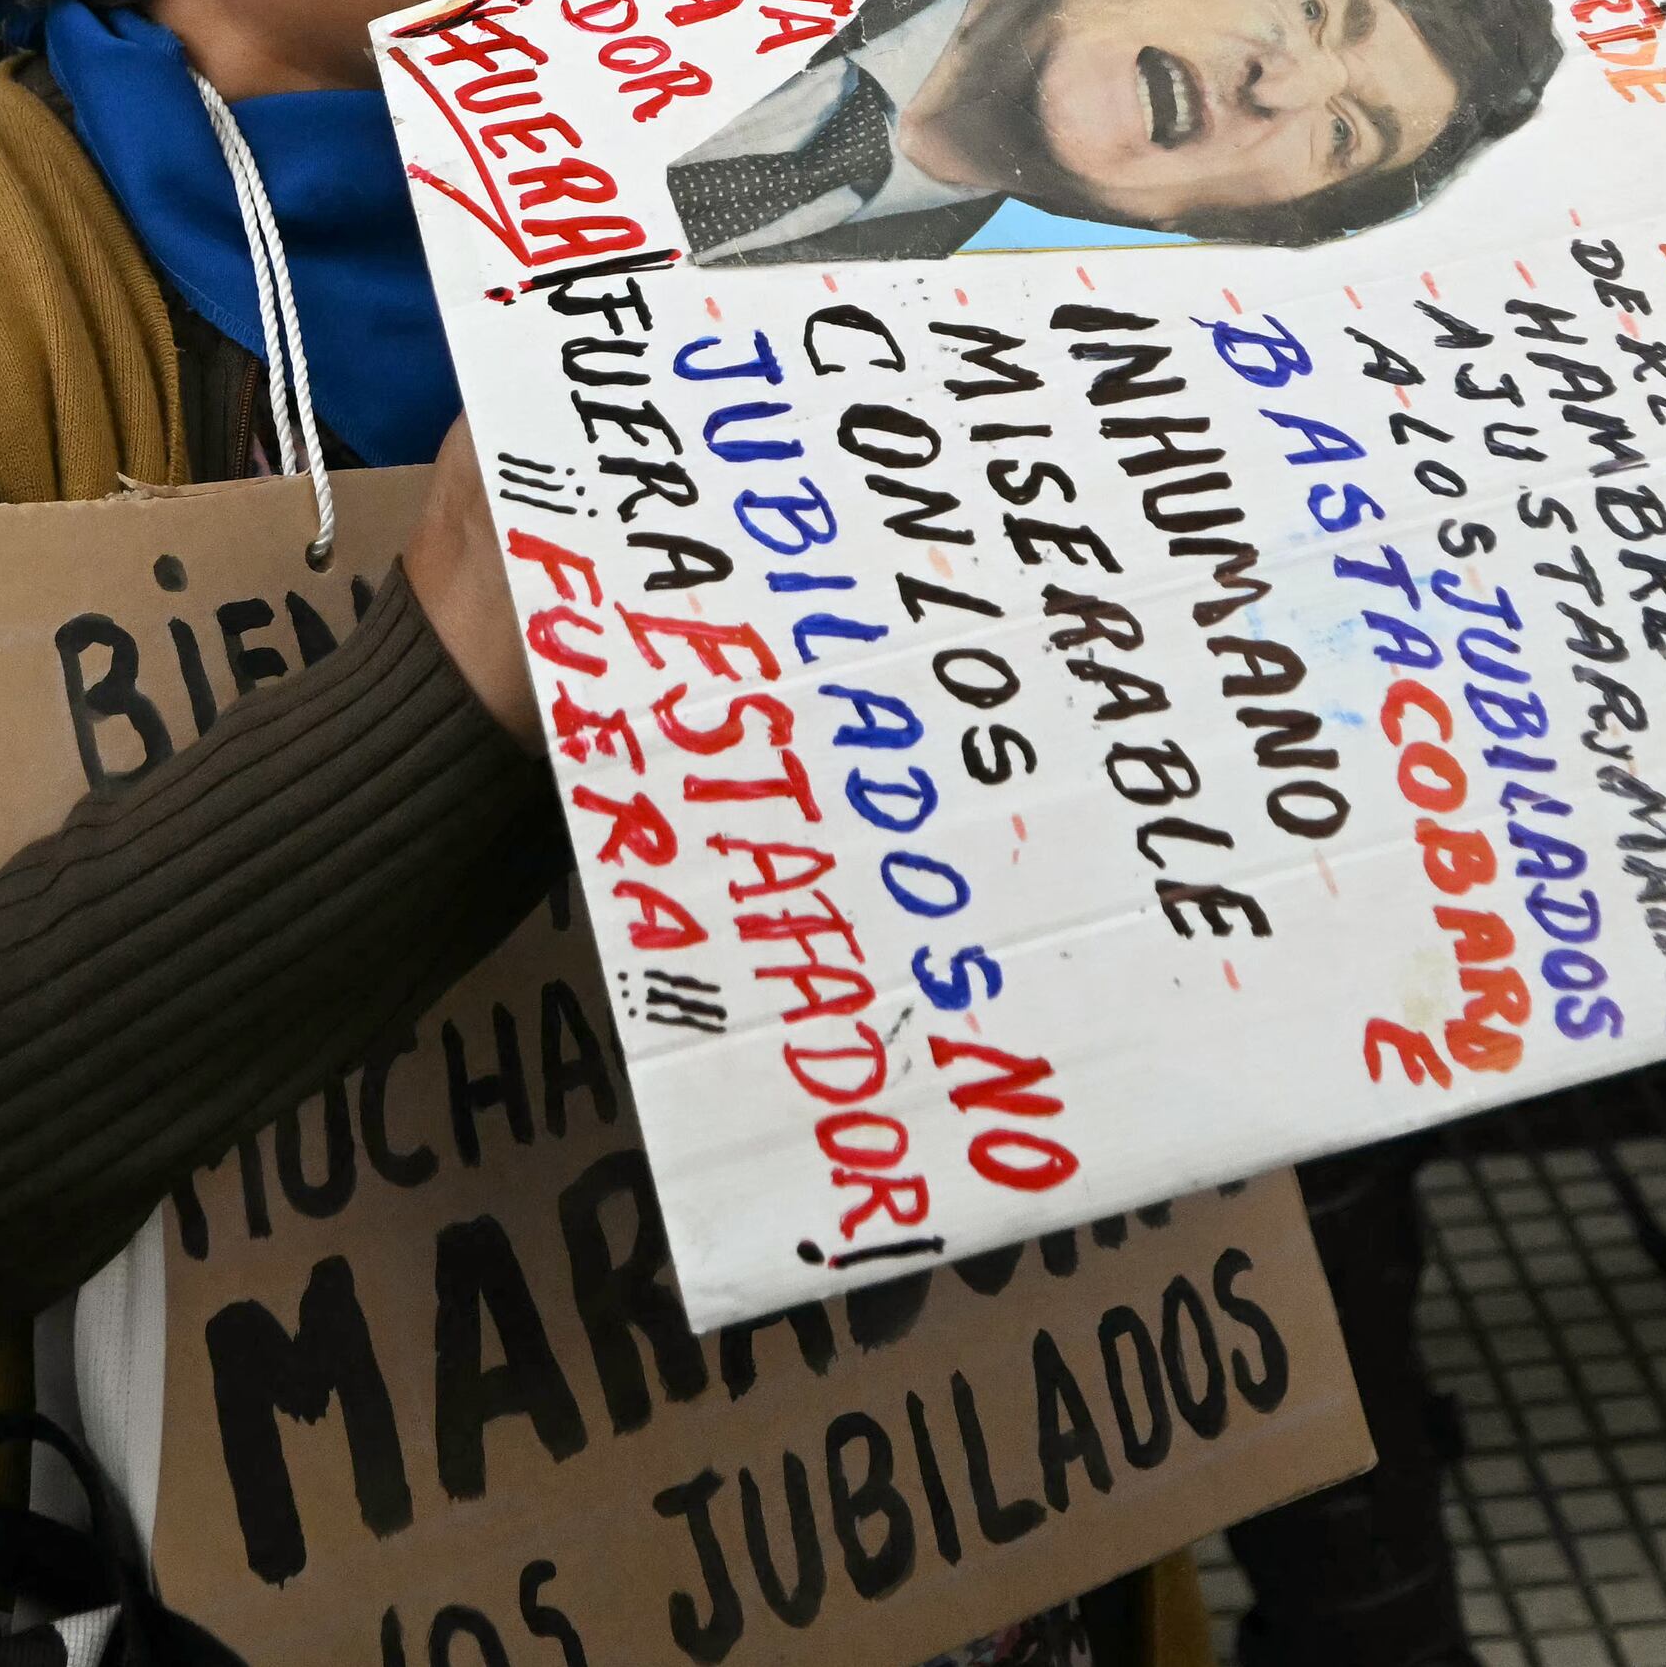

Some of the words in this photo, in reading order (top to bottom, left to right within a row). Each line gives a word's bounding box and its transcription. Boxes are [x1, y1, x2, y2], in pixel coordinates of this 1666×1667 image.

[547, 274, 735, 592] FUERA
[1343, 325, 1425, 387] A
[1389, 411, 1497, 558] LOS
[1571, 238, 1653, 315] DE
[803, 303, 976, 546] CON
[896, 572, 1038, 785] LOS
[927, 320, 1274, 939] MISERABLE
[1049, 304, 1352, 840] INHUMANO
[1191, 313, 1444, 668] BASTA
[1413, 299, 1649, 734] AJUSTAR
[673, 329, 1004, 1013] JUBILADOS
[927, 1034, 1081, 1193] NO
[1429, 567, 1623, 1040] JUBILADOS
[652, 1246, 1290, 1661] JUBILADOS
